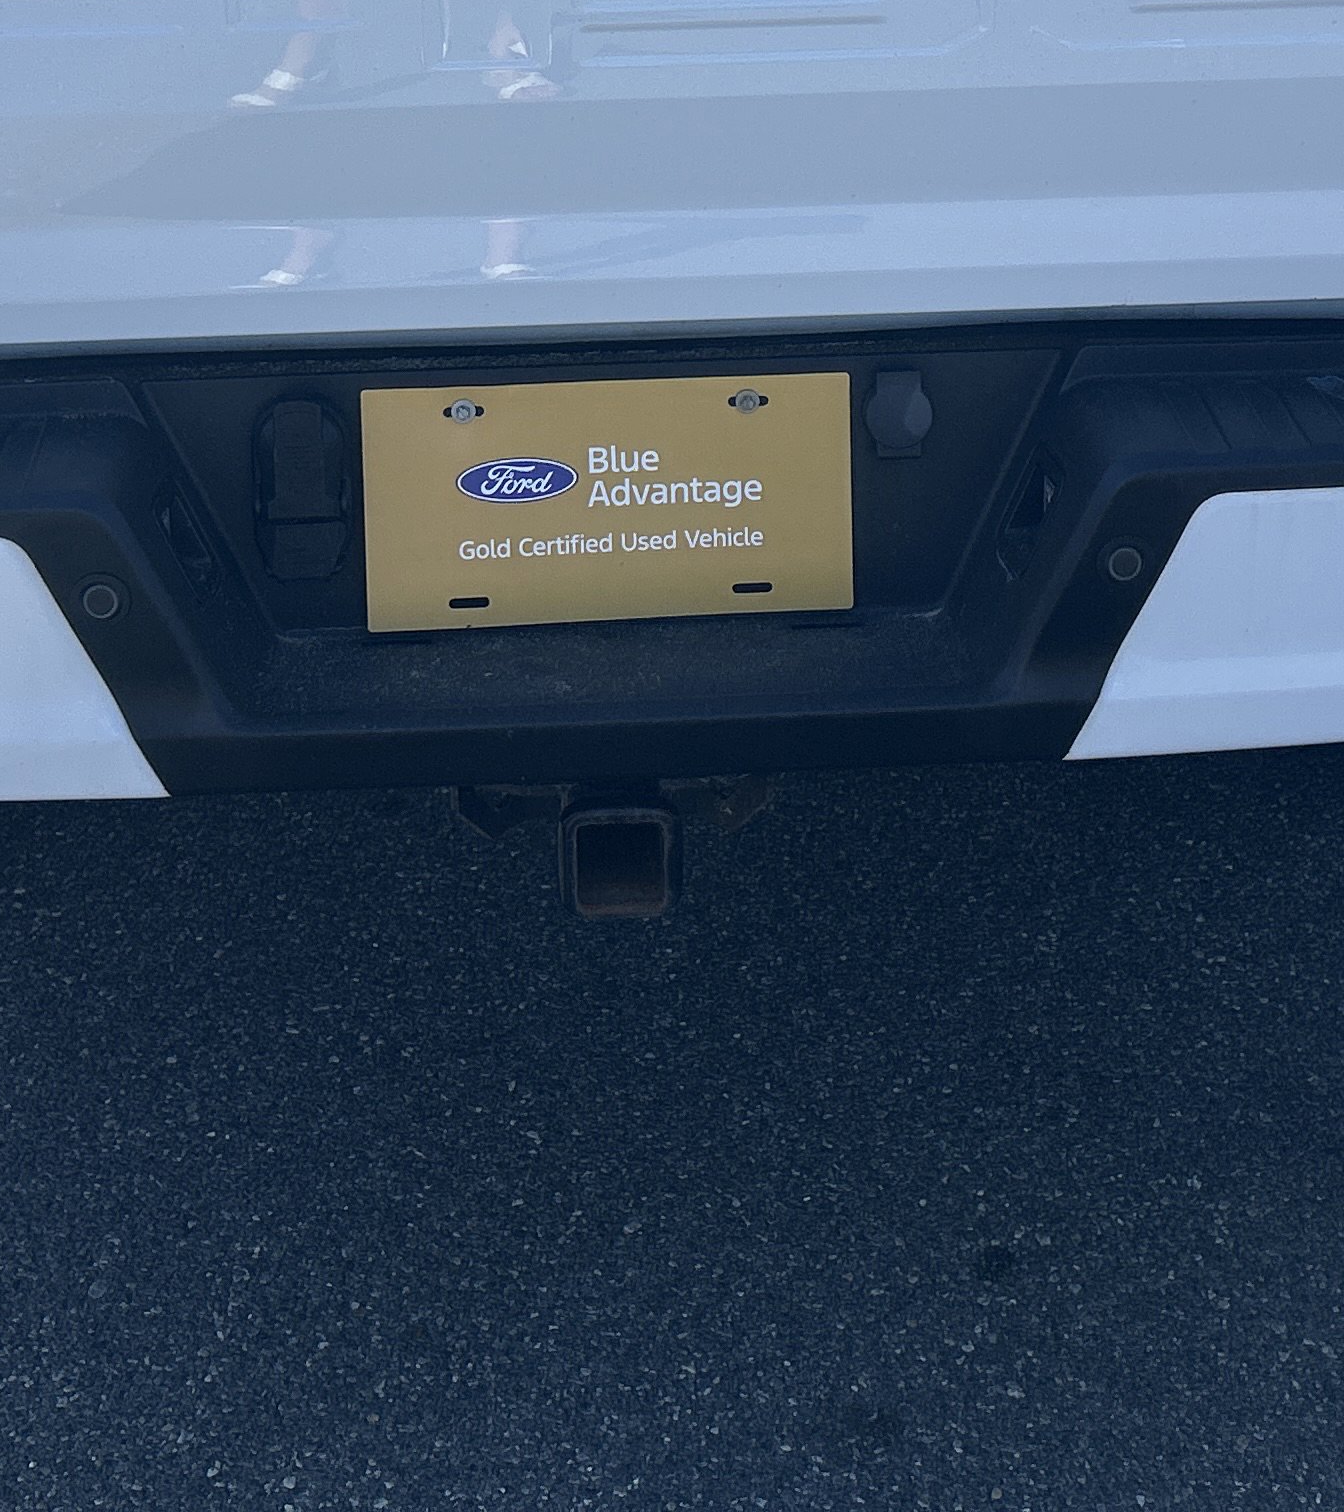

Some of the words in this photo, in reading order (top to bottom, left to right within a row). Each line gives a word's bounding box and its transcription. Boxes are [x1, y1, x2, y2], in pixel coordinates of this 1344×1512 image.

[587, 445, 660, 474] Blue
[479, 464, 553, 496] Ford
[587, 474, 764, 509] Advantage
[458, 538, 512, 562] Gold
[518, 532, 613, 557] Certified
[620, 530, 678, 553] Used
[683, 526, 765, 550] Vehicle
